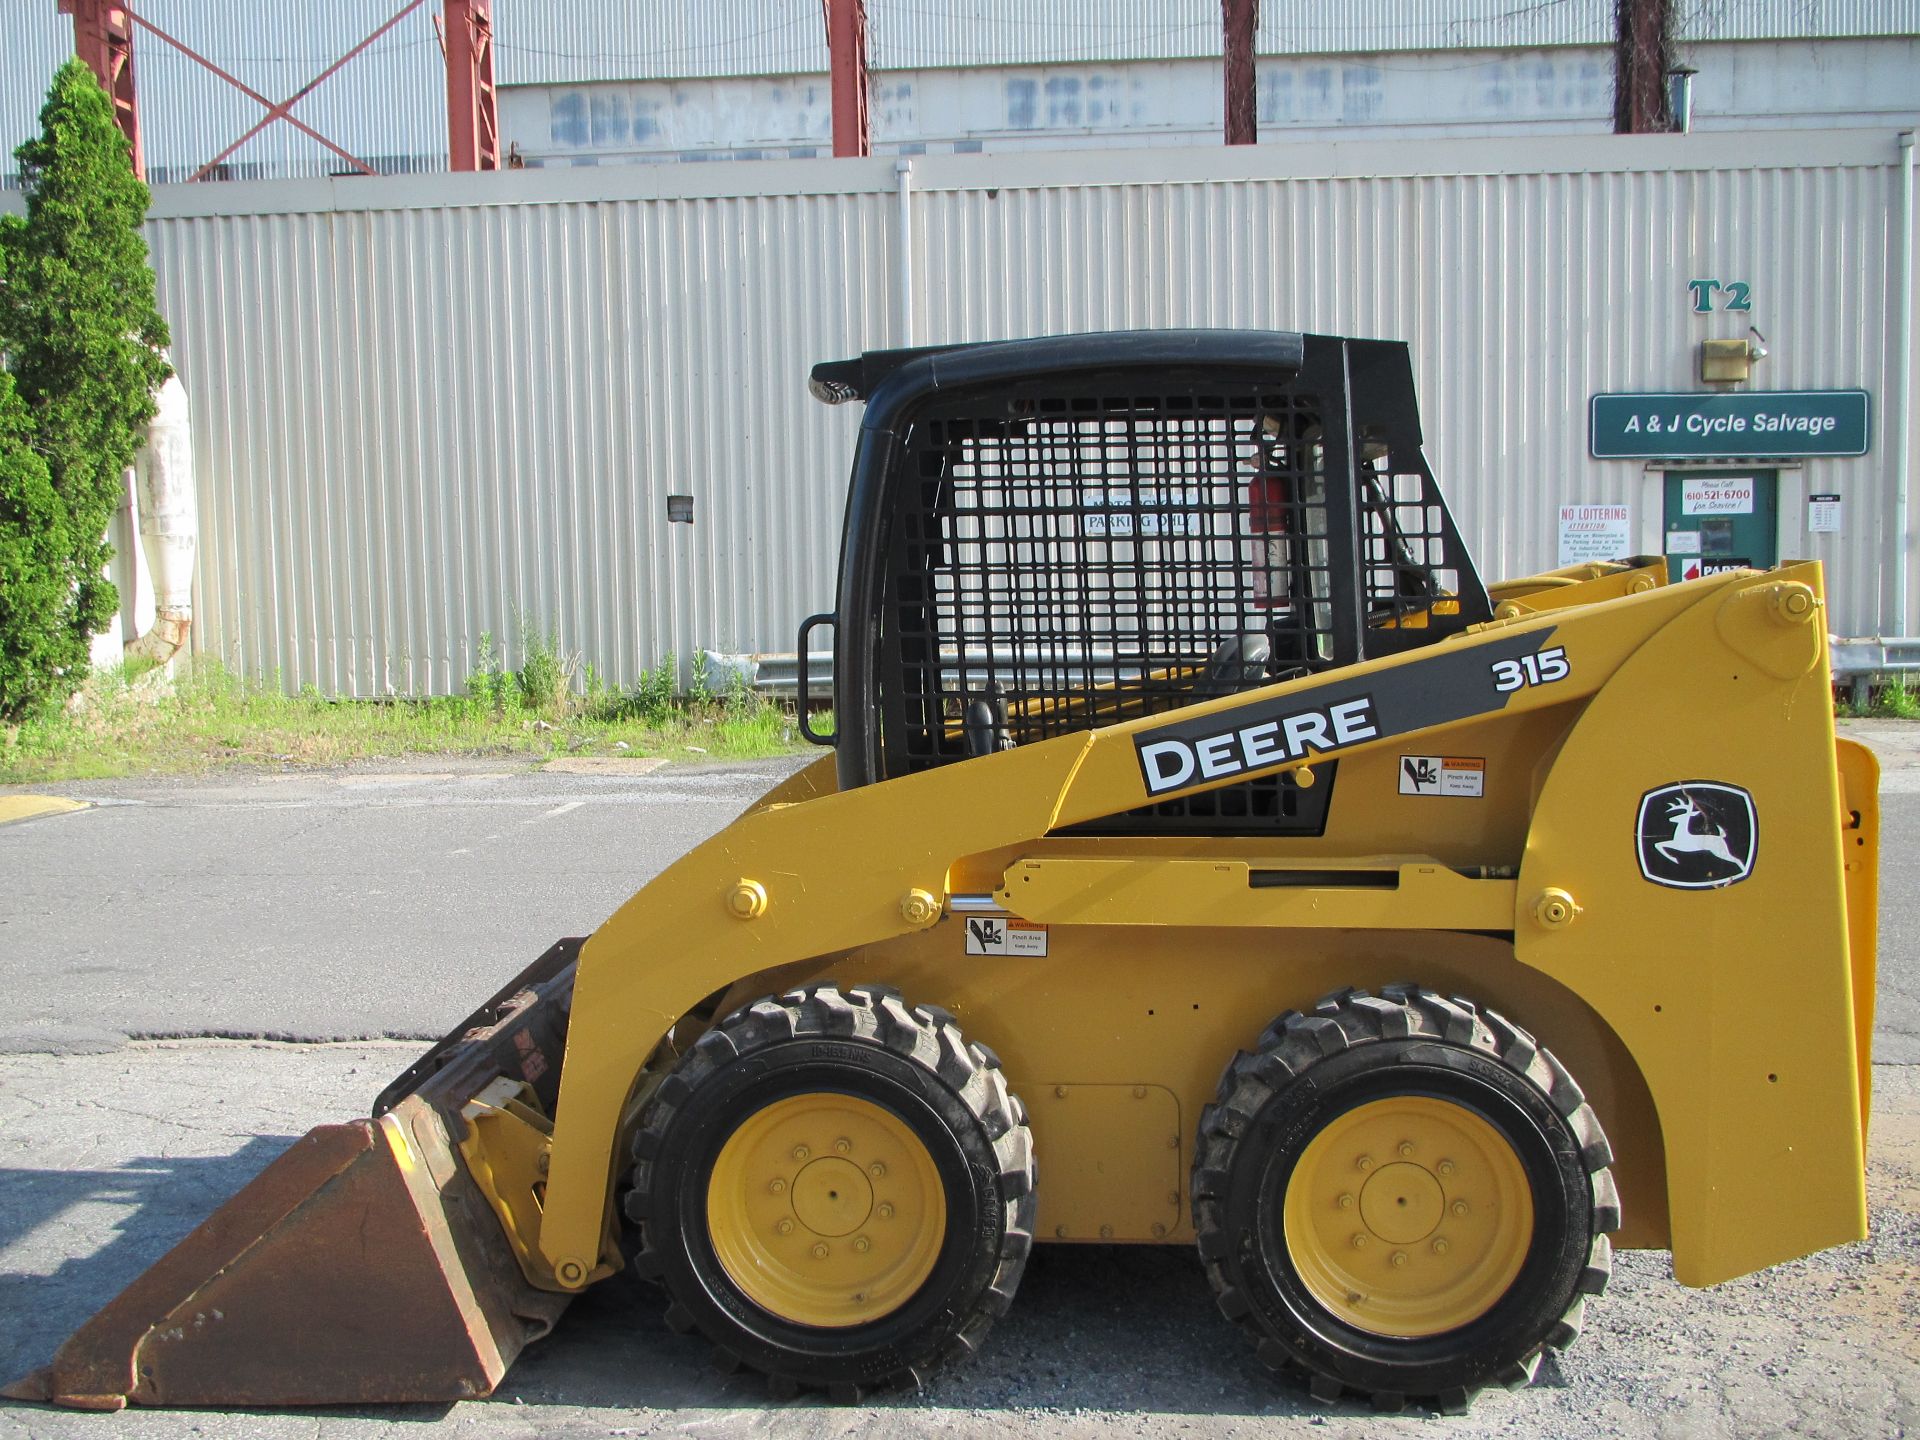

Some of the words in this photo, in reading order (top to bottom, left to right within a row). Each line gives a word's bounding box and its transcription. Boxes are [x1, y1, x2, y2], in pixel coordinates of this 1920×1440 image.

[1624, 415, 1640, 433] A
[1646, 415, 1661, 433] &
[1667, 414, 1681, 433] J
[1686, 414, 1746, 437] Cycle
[1752, 413, 1836, 435] Salvage
[1561, 508, 1575, 521] NO
[1578, 508, 1627, 521] LOITERING
[1491, 648, 1569, 692] 315
[1140, 698, 1377, 792] DEERE
